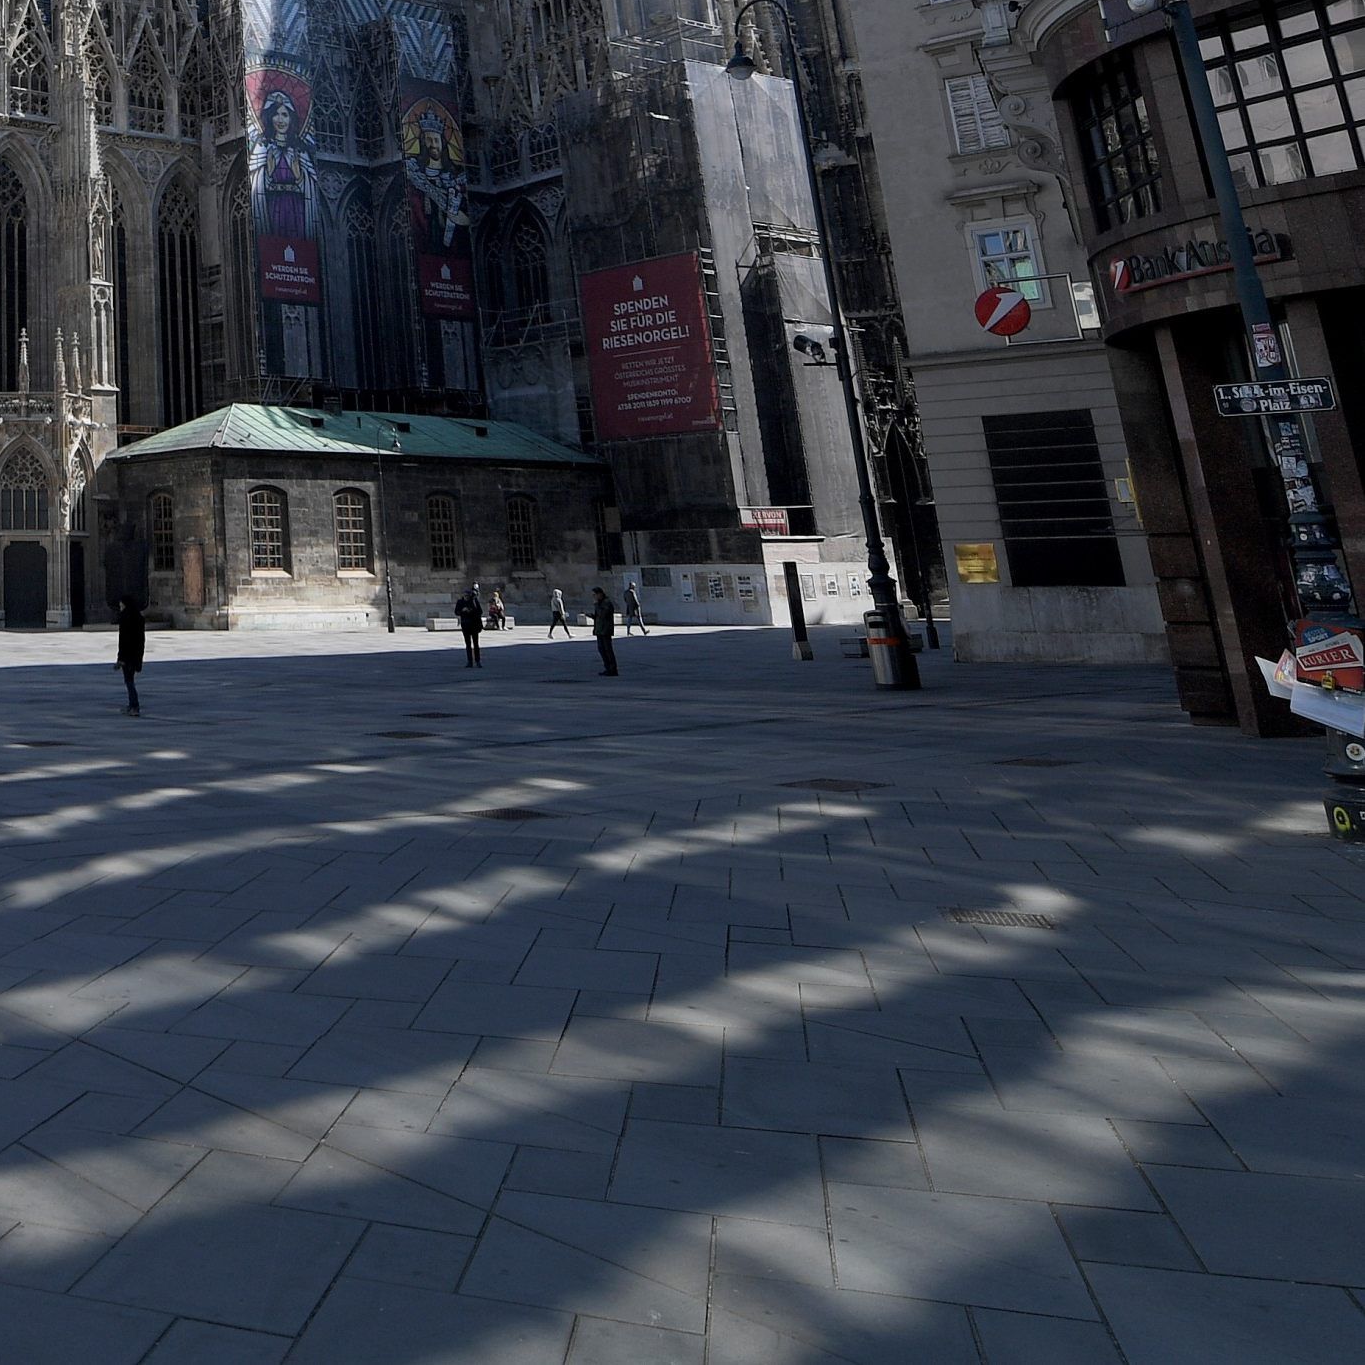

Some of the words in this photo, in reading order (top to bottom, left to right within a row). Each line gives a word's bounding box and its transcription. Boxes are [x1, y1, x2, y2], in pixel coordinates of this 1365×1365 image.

[271, 264, 298, 274] WERDEN
[1129, 244, 1185, 283] Bank
[614, 295, 669, 315] SPENDEN
[610, 318, 628, 332] SIE
[630, 312, 653, 329] FÜR
[656, 310, 676, 325] DIE
[602, 325, 689, 350] RIESENORGEL!
[1259, 399, 1292, 412] Platz
[1301, 648, 1355, 667] KURIER
